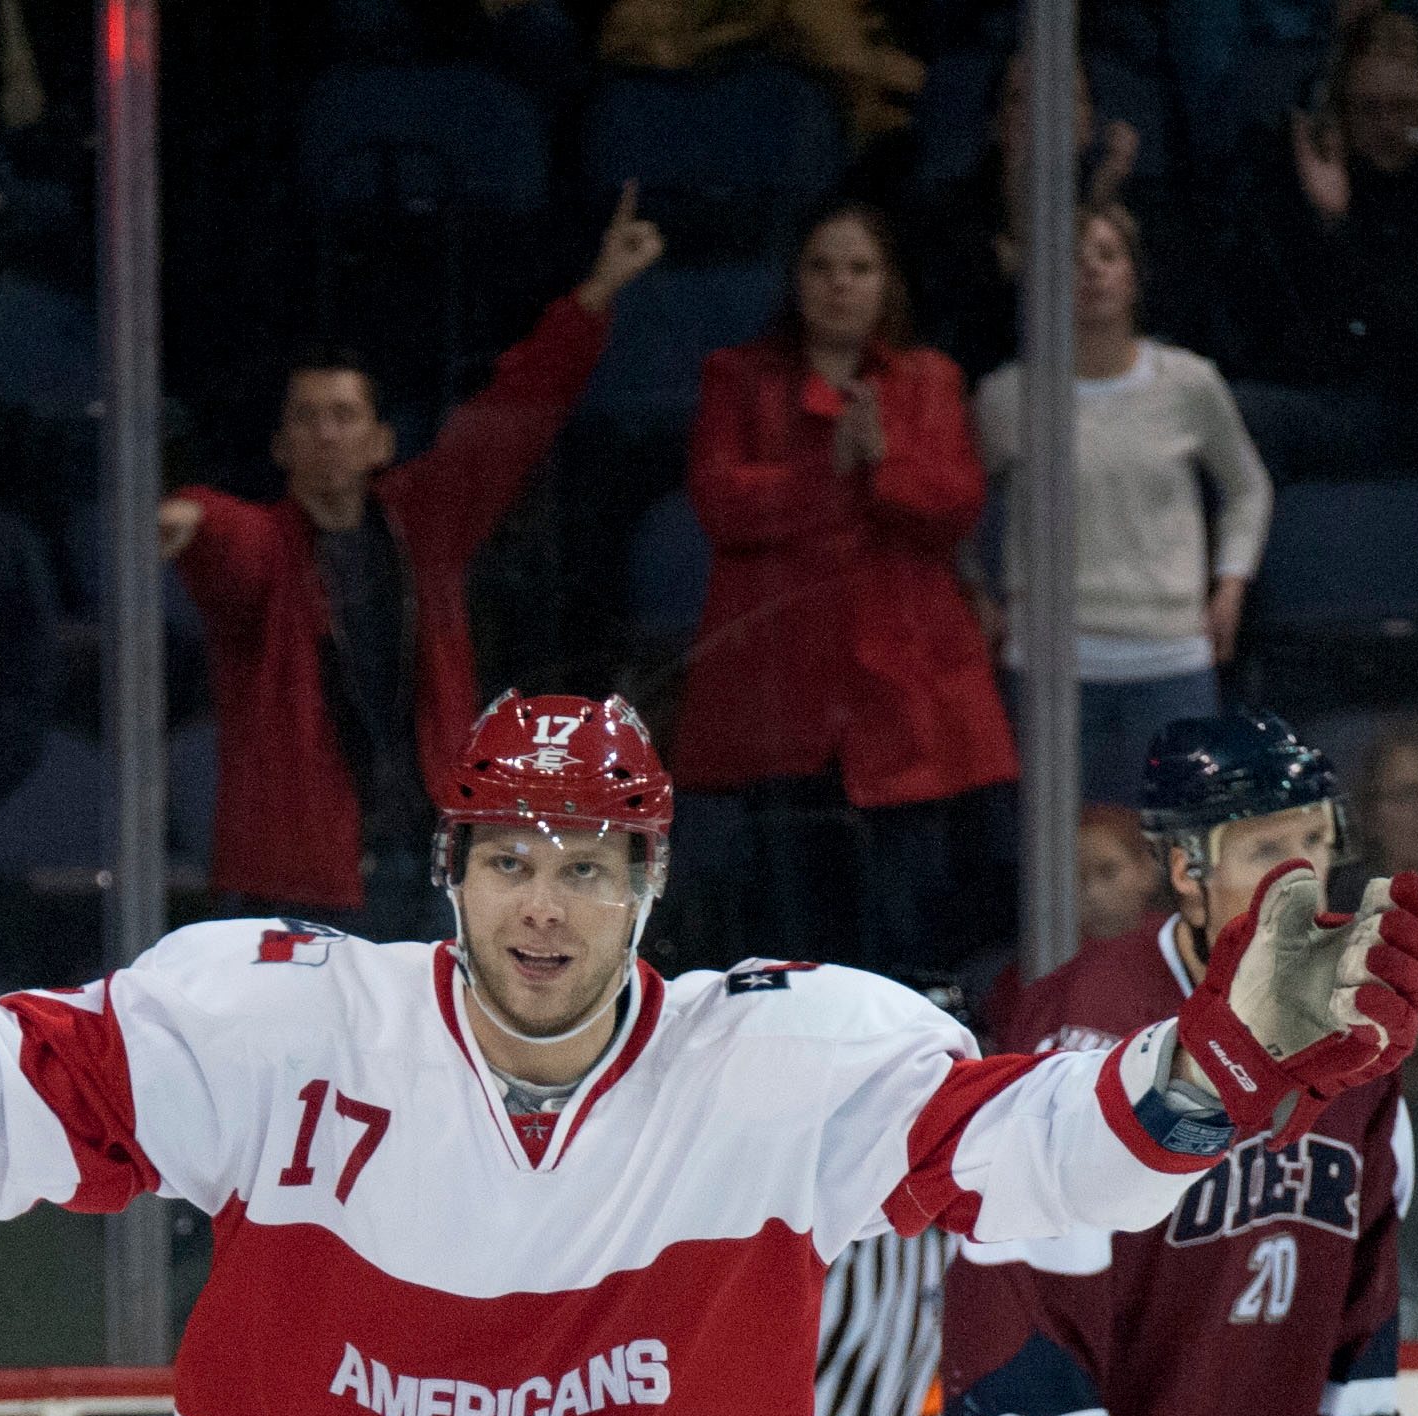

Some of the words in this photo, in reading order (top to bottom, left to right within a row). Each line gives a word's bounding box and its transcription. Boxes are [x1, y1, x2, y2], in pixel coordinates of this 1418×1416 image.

[532, 715, 580, 745] 17
[277, 1079, 392, 1206] 17
[1229, 1231, 1298, 1323] 20
